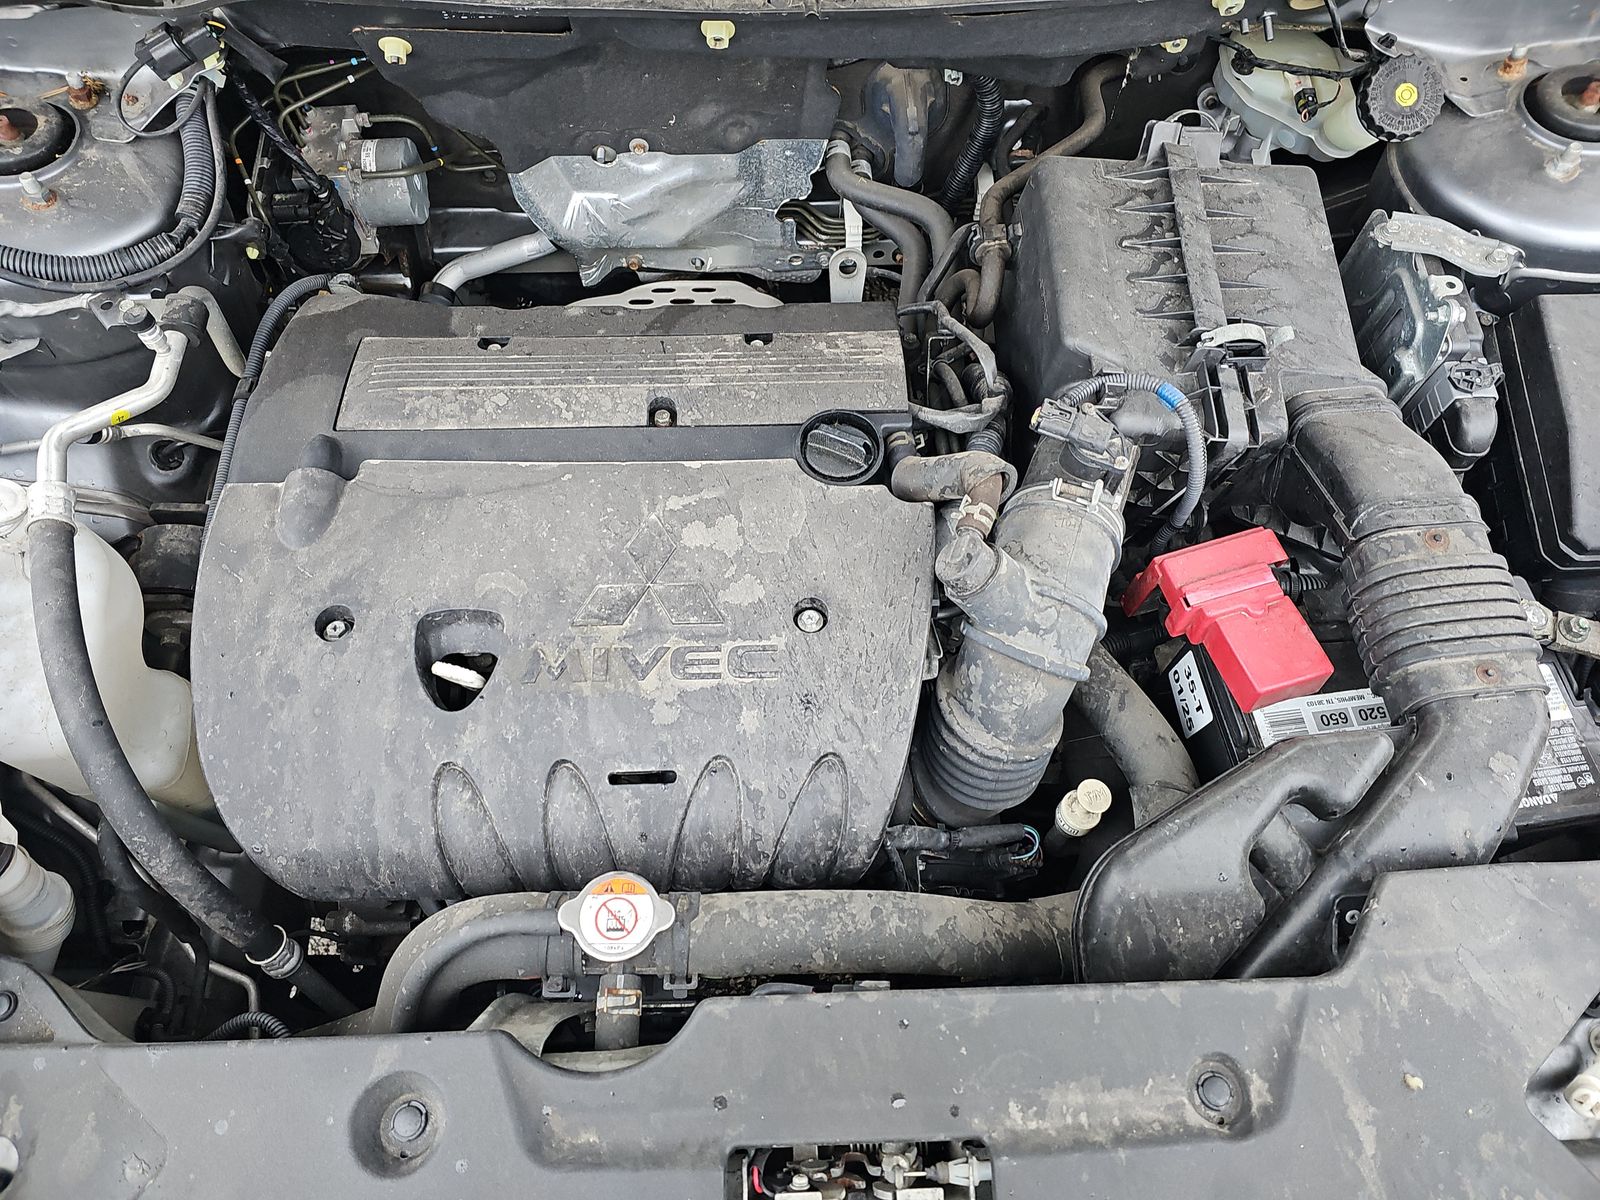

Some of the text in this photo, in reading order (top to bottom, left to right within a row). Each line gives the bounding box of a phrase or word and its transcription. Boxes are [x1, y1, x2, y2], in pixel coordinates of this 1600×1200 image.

[521, 644, 780, 684] MIVEC
[1173, 669, 1195, 731] 01/25
[1184, 665, 1204, 714] 35-T
[1334, 694, 1366, 704] MEMPHIS,
[1320, 706, 1387, 726] 520 650
